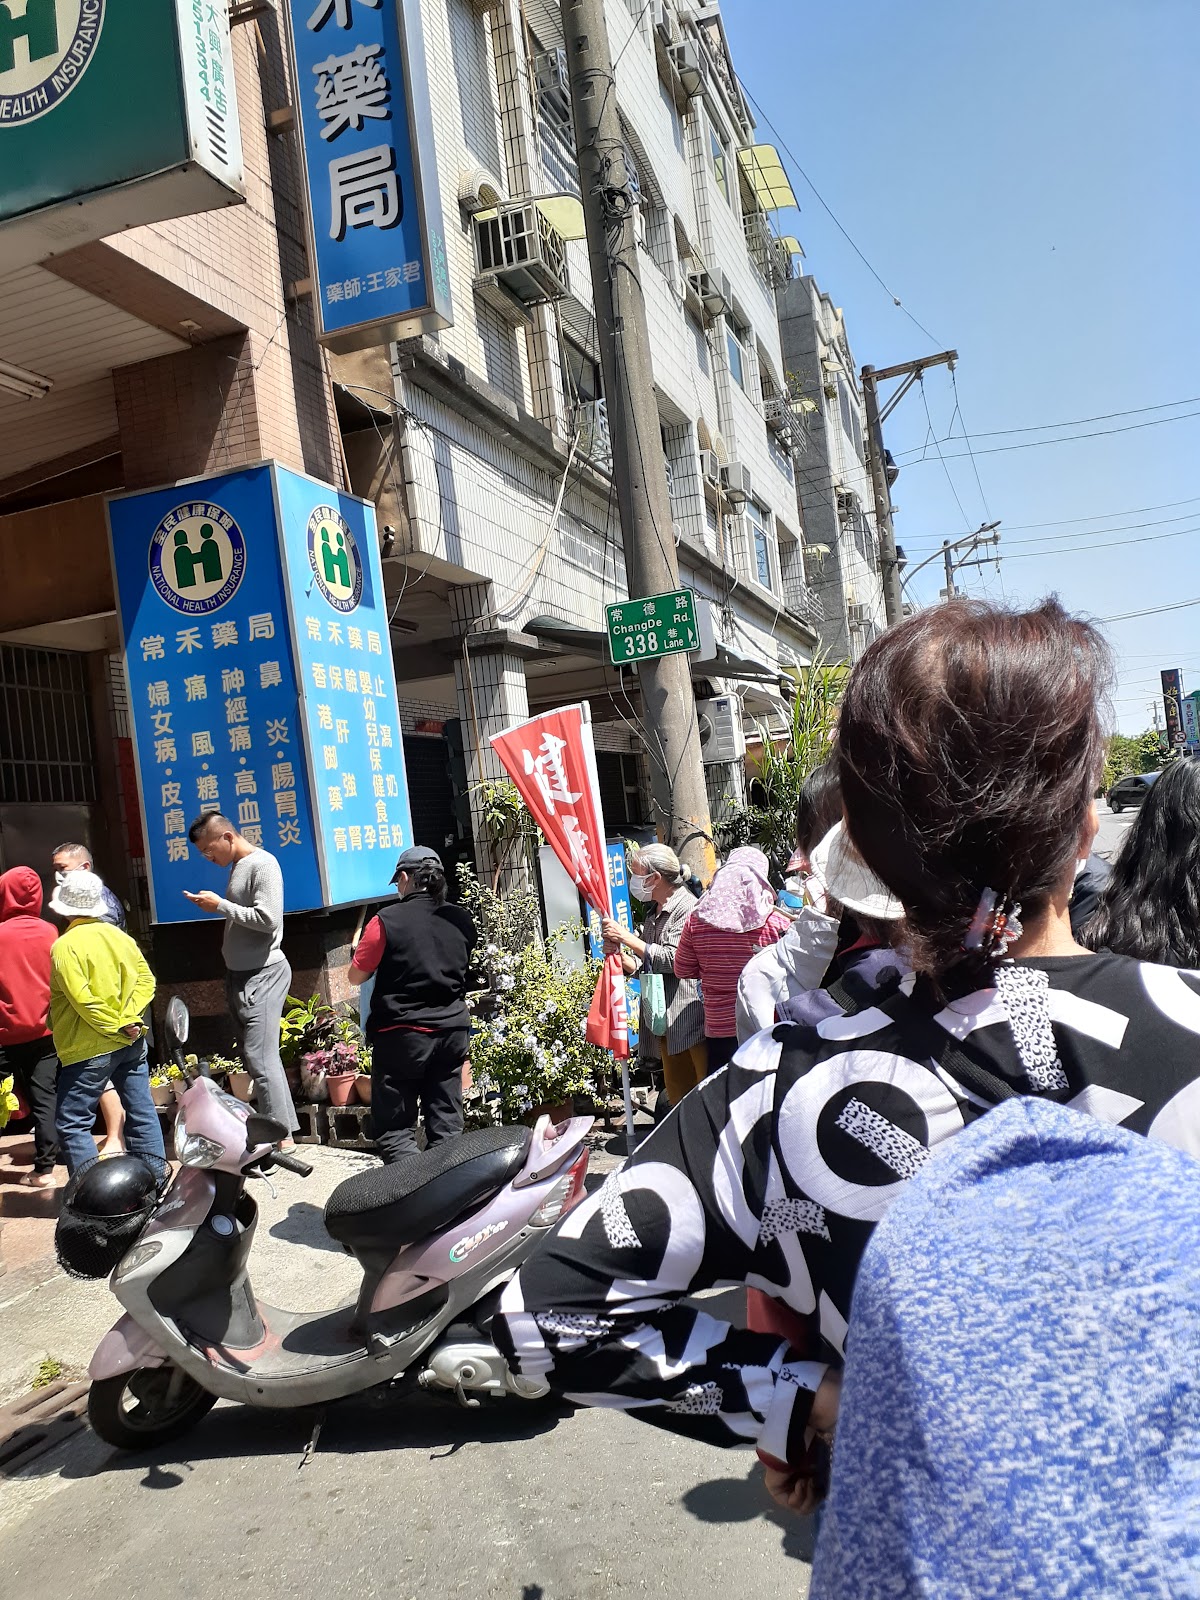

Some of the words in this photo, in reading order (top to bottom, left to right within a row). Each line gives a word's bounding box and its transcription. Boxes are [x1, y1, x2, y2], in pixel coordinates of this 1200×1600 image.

[0, 86, 49, 119] EALTH
[154, 503, 233, 546] 全民健康保險
[152, 566, 180, 607] NATIONAL
[182, 598, 217, 612] HEALTH
[217, 547, 243, 603] INSURANCE
[611, 595, 688, 622] 常德路
[613, 619, 663, 635] ChangDe
[673, 612, 691, 624] Rd.
[140, 612, 276, 662] 常禾藥局
[305, 615, 382, 656] 常禾藥局
[624, 631, 658, 656] 338
[663, 638, 684, 649] Lane
[667, 628, 678, 639] 巷
